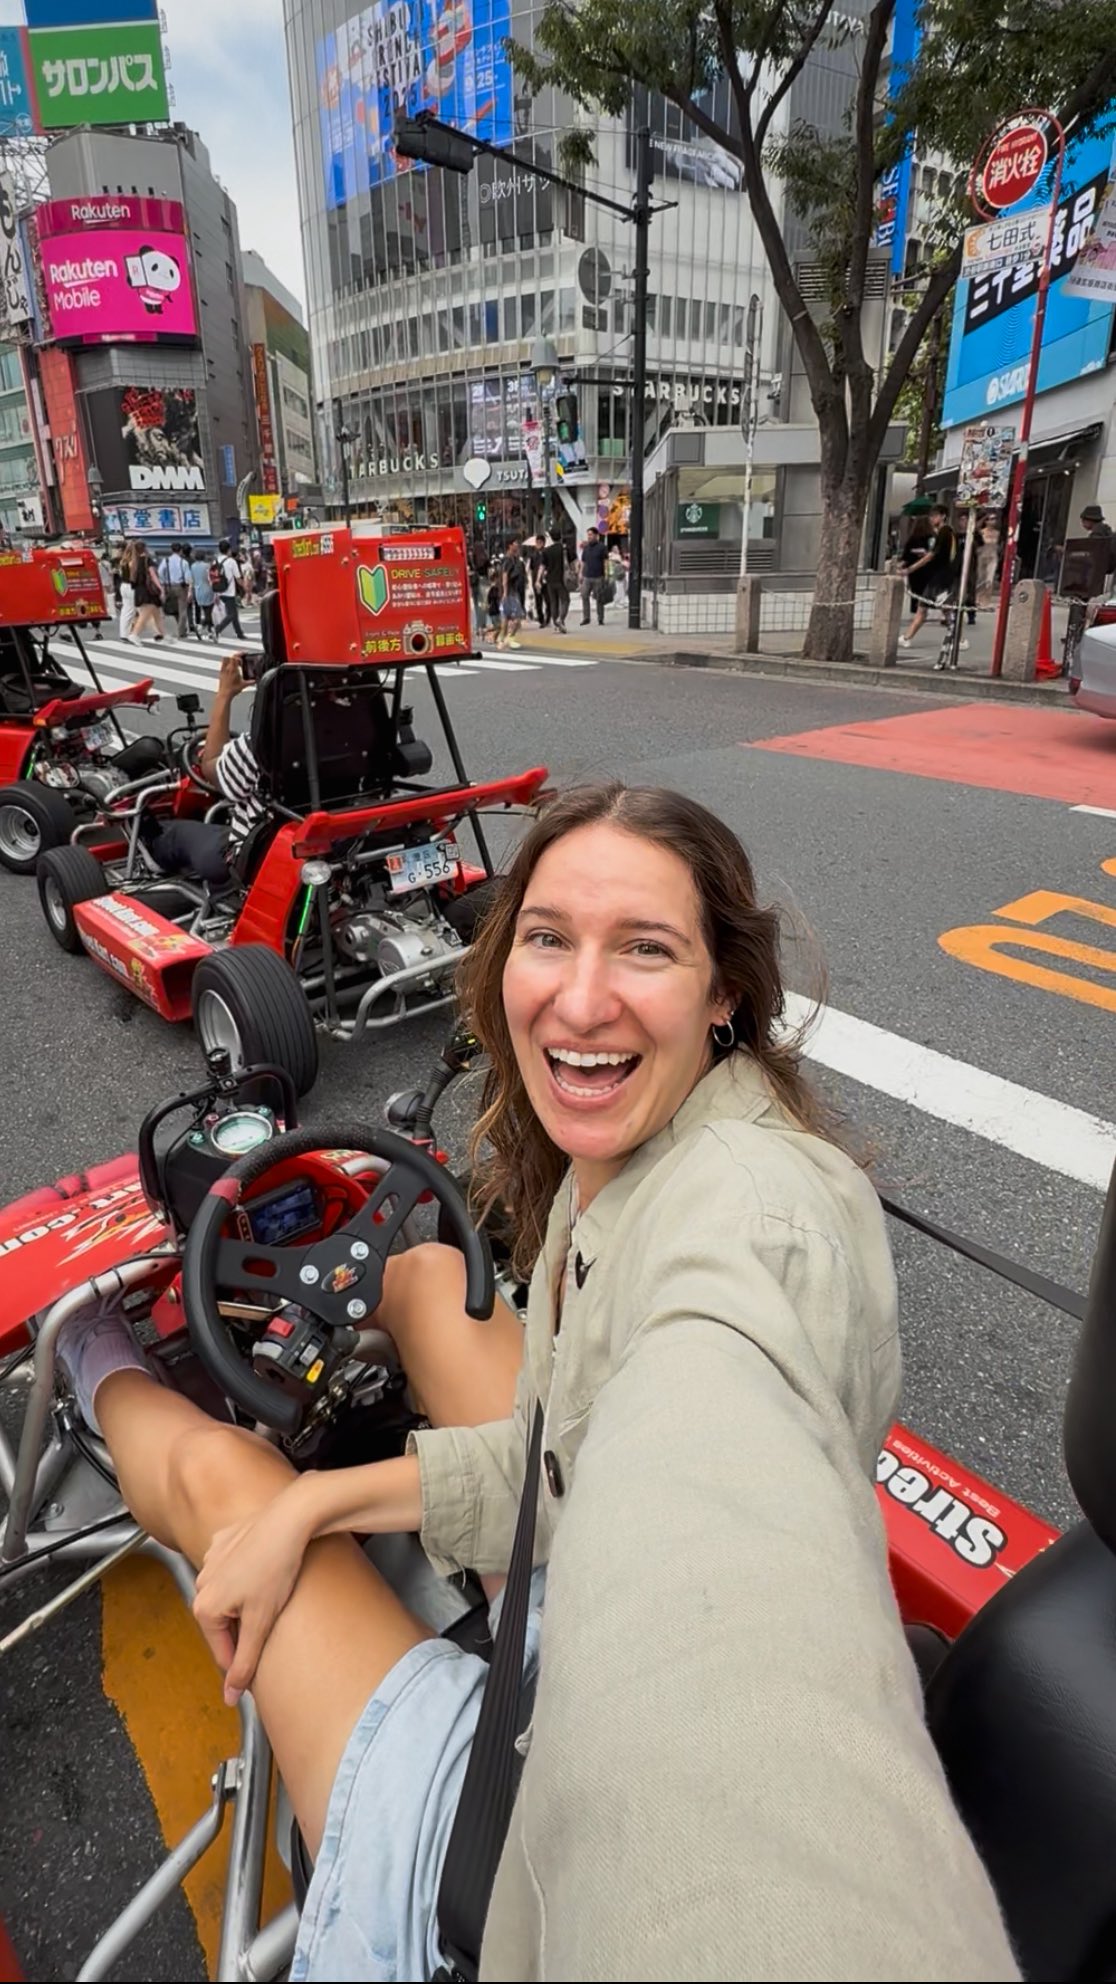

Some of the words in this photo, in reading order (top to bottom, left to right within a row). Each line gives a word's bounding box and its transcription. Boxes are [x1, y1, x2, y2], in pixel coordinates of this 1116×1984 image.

[42, 54, 158, 97] サロンパス
[989, 145, 1042, 190] 消火栓
[71, 203, 131, 221] Rakuten
[986, 221, 1037, 251] 七田式
[50, 257, 118, 285] Rakuten
[54, 287, 101, 311] Mobile
[613, 377, 740, 406] SARBUCKS
[128, 465, 206, 490] DMM
[391, 568, 421, 579] DRIVE
[892, 1440, 962, 1488] Activities
[962, 1488, 1000, 1518] Best
